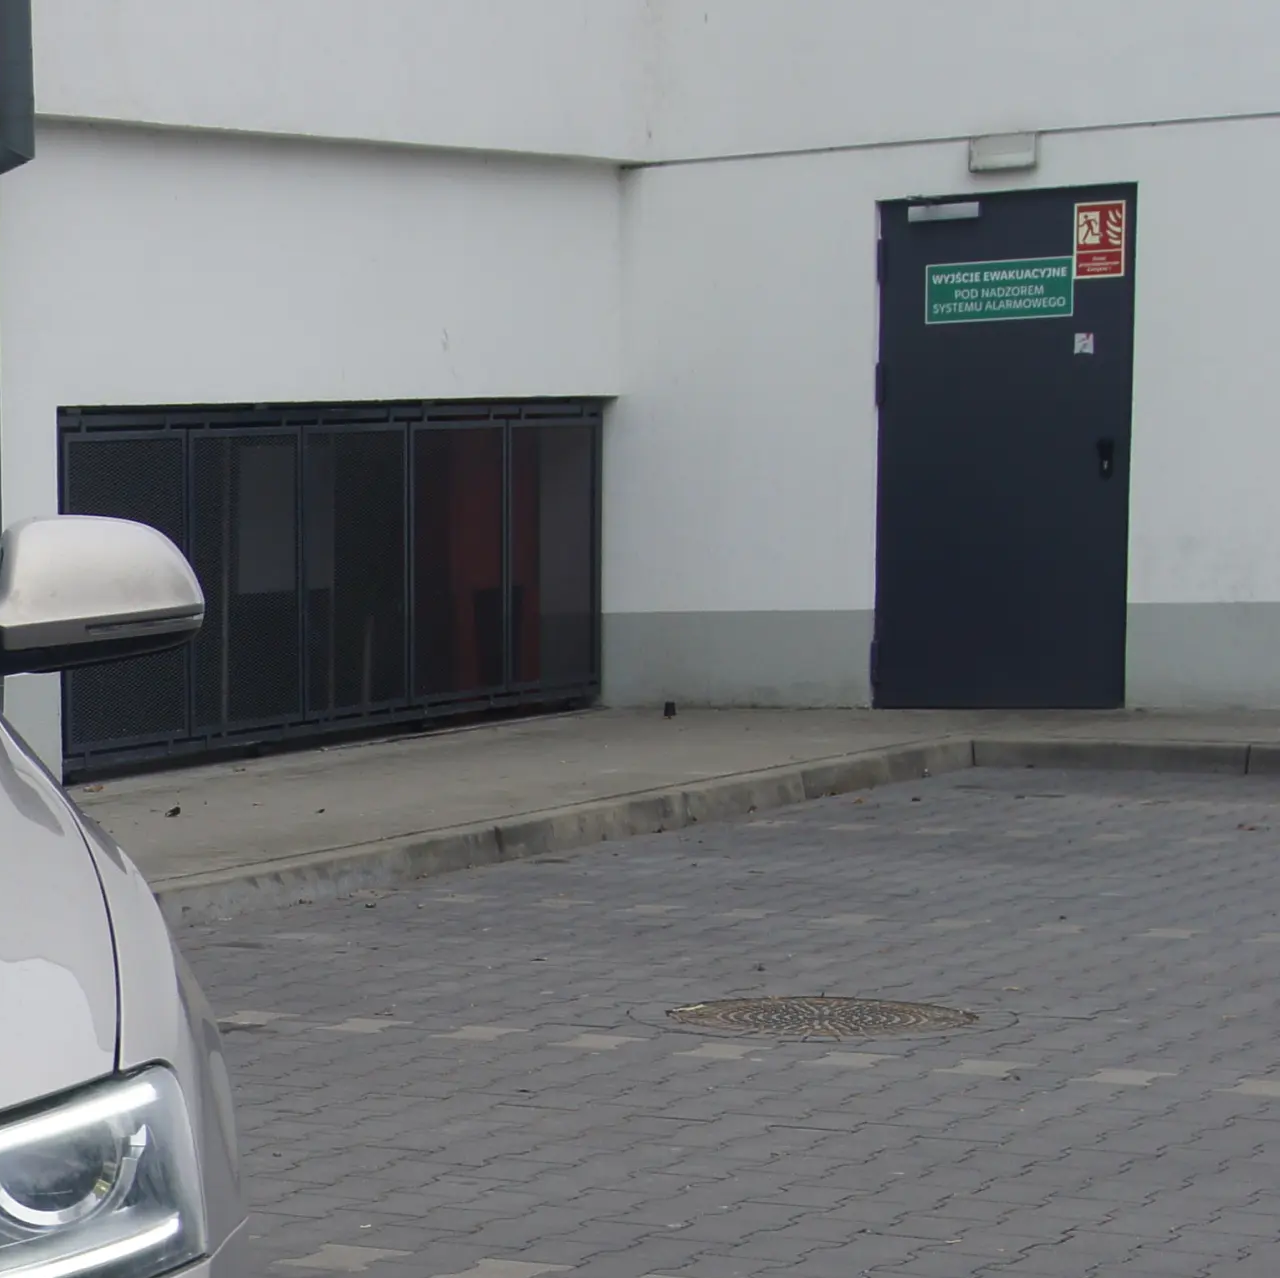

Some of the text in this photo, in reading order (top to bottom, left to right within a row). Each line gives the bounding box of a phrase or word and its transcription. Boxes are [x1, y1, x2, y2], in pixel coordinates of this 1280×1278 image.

[932, 272, 981, 285] WYJŚCIE
[983, 266, 1069, 282] EWAKUACYJNE
[954, 284, 1045, 300] POD NADZOREM
[933, 296, 1067, 315] SYSTEMU ALARMOWEGO
